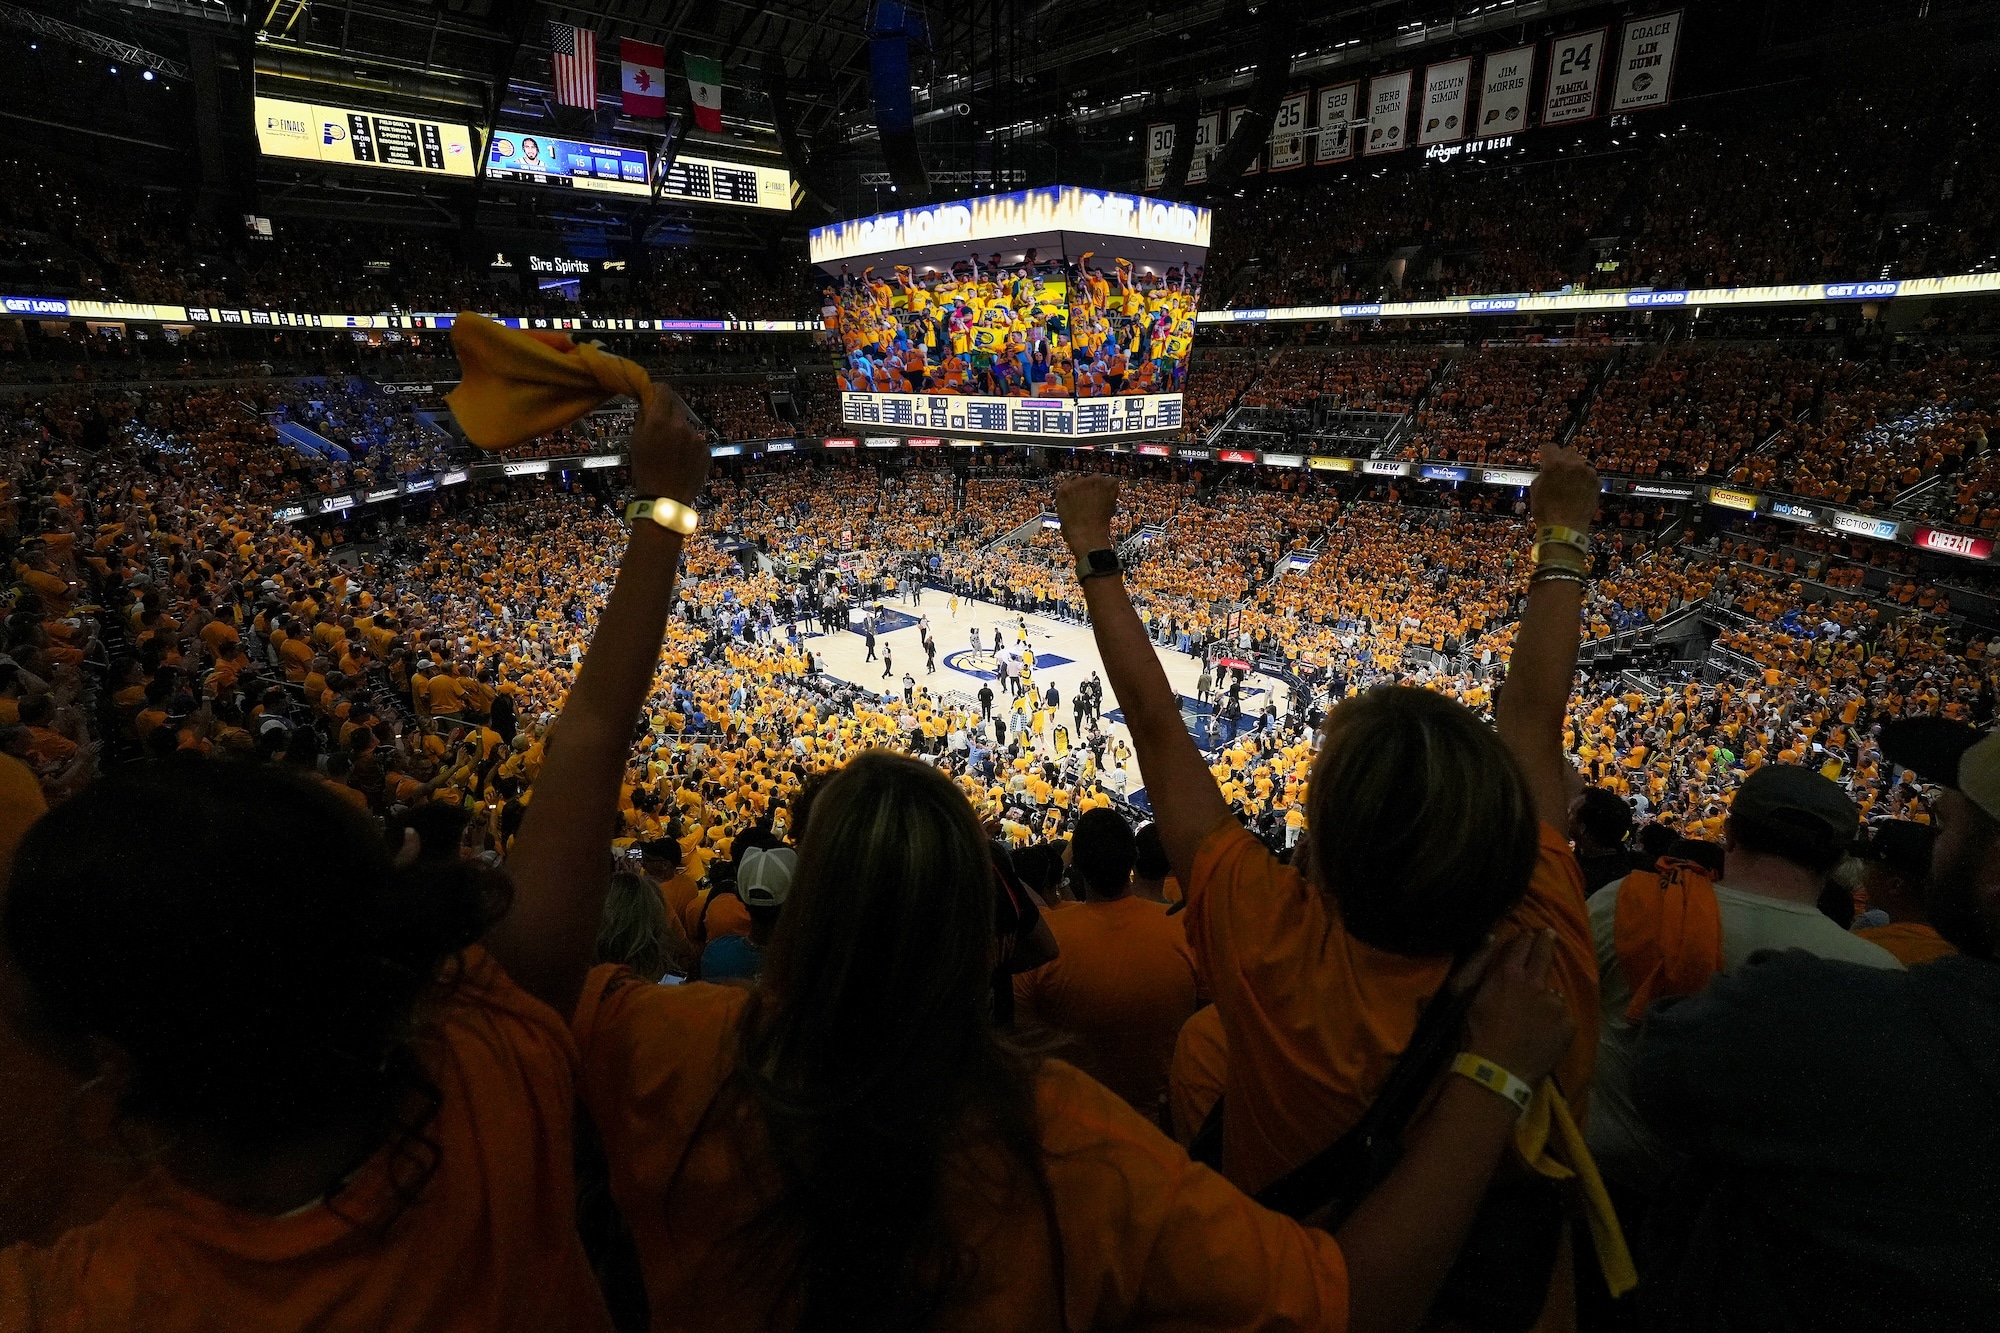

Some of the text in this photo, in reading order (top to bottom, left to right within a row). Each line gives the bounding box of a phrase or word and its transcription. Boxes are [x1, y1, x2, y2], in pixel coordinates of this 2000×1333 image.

[1632, 22, 1671, 41] COACH
[1637, 42, 1658, 56] LIN
[1559, 43, 1594, 76] 24
[1629, 54, 1663, 70] DUNN
[1498, 65, 1518, 78] JIM
[1429, 76, 1464, 92] MELVIN
[1488, 78, 1524, 93] MORRIS
[1556, 80, 1588, 96] TAMIKA
[1327, 93, 1348, 109] 529
[1378, 90, 1400, 103] HERB
[1431, 89, 1460, 104] SIMON
[1549, 91, 1592, 109] CATCHINGS
[1278, 101, 1301, 128] 35
[1375, 101, 1401, 115] SIMON
[280, 118, 306, 133] FINALS
[1154, 130, 1172, 151] 30
[547, 145, 555, 159] 1
[589, 147, 621, 158] GAME STATS
[1425, 136, 1513, 163] Kroger SKY DECK
[575, 158, 585, 168] 15
[605, 161, 611, 170] 4
[623, 164, 642, 174] 4/10
[1083, 193, 1197, 239] GET LOUD
[860, 206, 971, 248] GET LOUD
[529, 256, 553, 271] Sire
[554, 257, 590, 275] Spirits
[1827, 283, 1896, 297] GET LOUD
[1470, 300, 1516, 310] GET LOUD
[1628, 293, 1684, 304] GET LOUD
[6, 299, 67, 313] GET LOUD
[1342, 305, 1379, 315] GET LOUD
[281, 316, 288, 325] 12
[1234, 309, 1266, 319] GET LOUD
[297, 318, 305, 326] 21
[535, 319, 547, 328] 90
[592, 319, 606, 328] 0.0
[638, 320, 649, 329] 60
[937, 399, 947, 408] 0.0
[1133, 400, 1144, 409] 0.0
[916, 415, 925, 424] 90
[953, 417, 963, 426] 60
[1112, 420, 1121, 429] 90
[1146, 418, 1155, 427] 60
[767, 442, 782, 450] ksm
[1177, 449, 1210, 457] AMBROSE
[1228, 451, 1245, 462] Lilly
[1319, 460, 1352, 469] GAINBRIDGE
[1372, 462, 1401, 471] IBEW
[1440, 467, 1458, 478] Kroger
[1483, 471, 1533, 485] aes Indian
[1635, 485, 1693, 496] Fanatics Sportsbook
[1714, 490, 1751, 504] Koorsen
[1773, 501, 1813, 518] IndyStar.
[1834, 516, 1893, 535] SECTION 127
[1927, 530, 1965, 554] CHEEZ-IT
